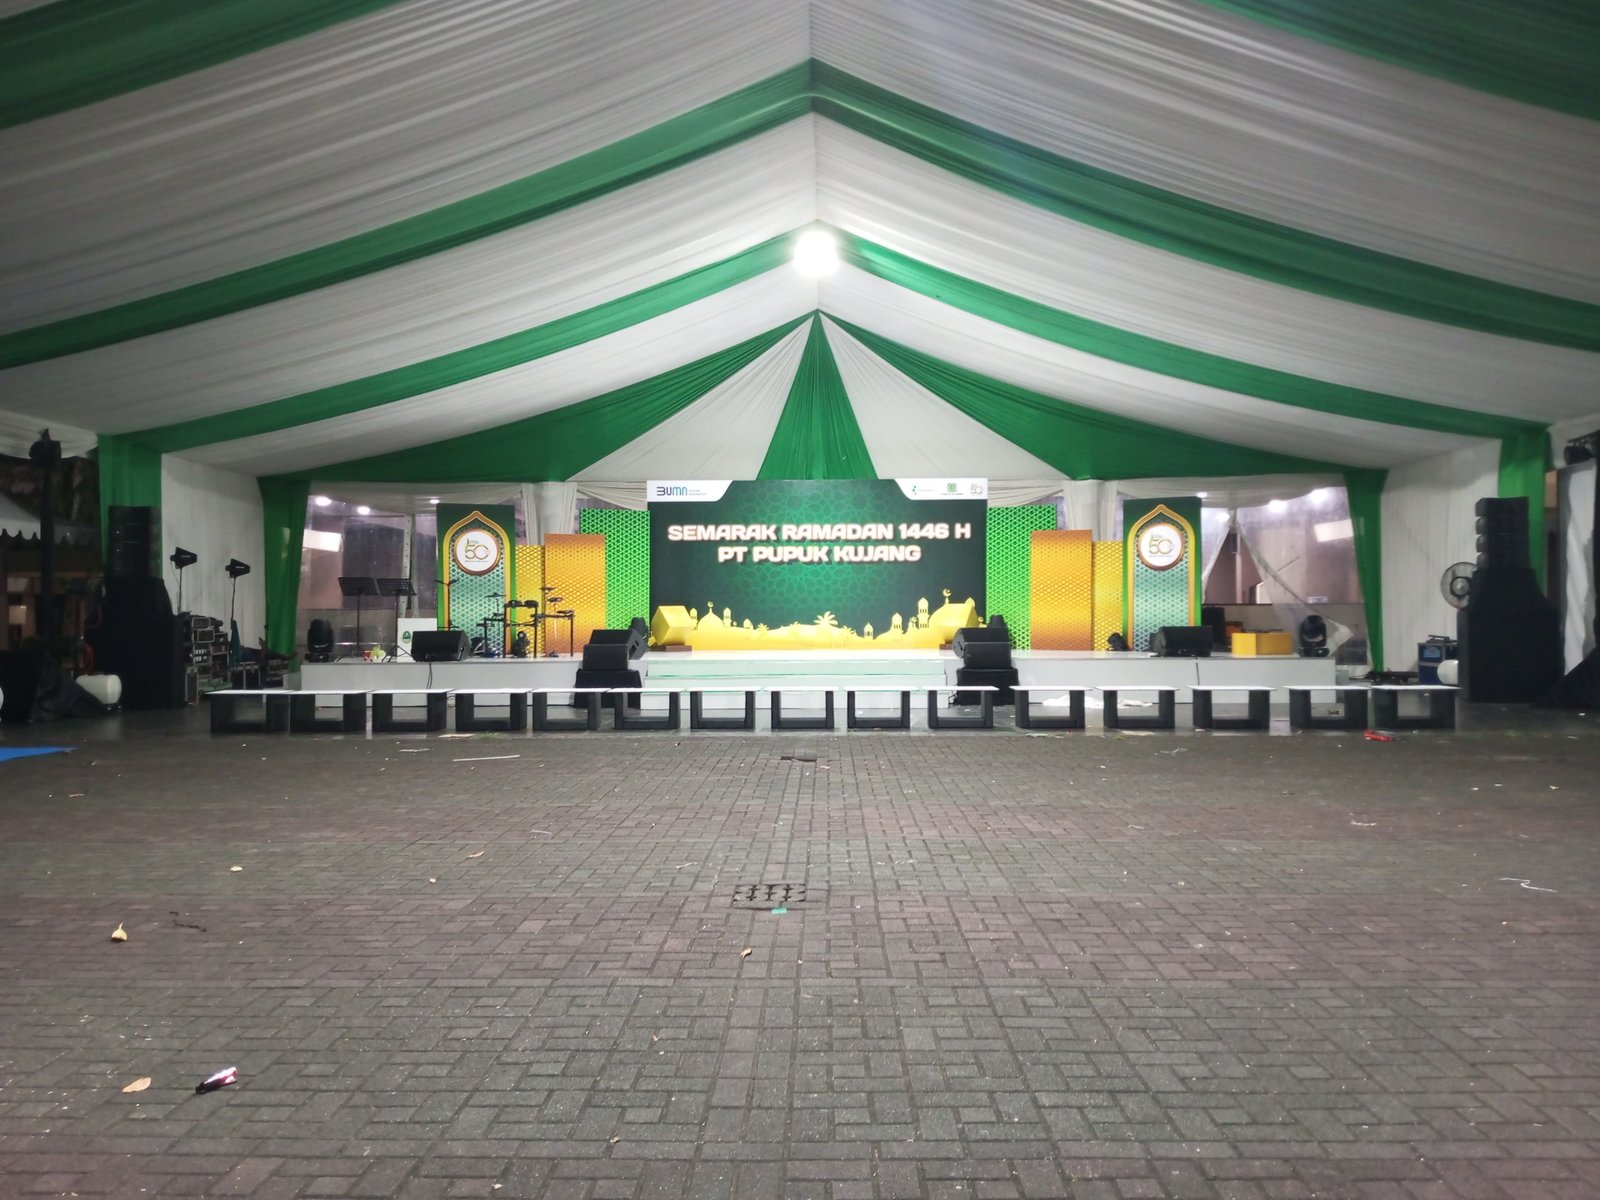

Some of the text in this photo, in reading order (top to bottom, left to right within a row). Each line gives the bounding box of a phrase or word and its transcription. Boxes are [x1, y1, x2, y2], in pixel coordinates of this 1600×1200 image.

[667, 523, 971, 541] SEMARAK RAMADAN 1446 H
[717, 545, 922, 563] PT PUPUK KUJANG
